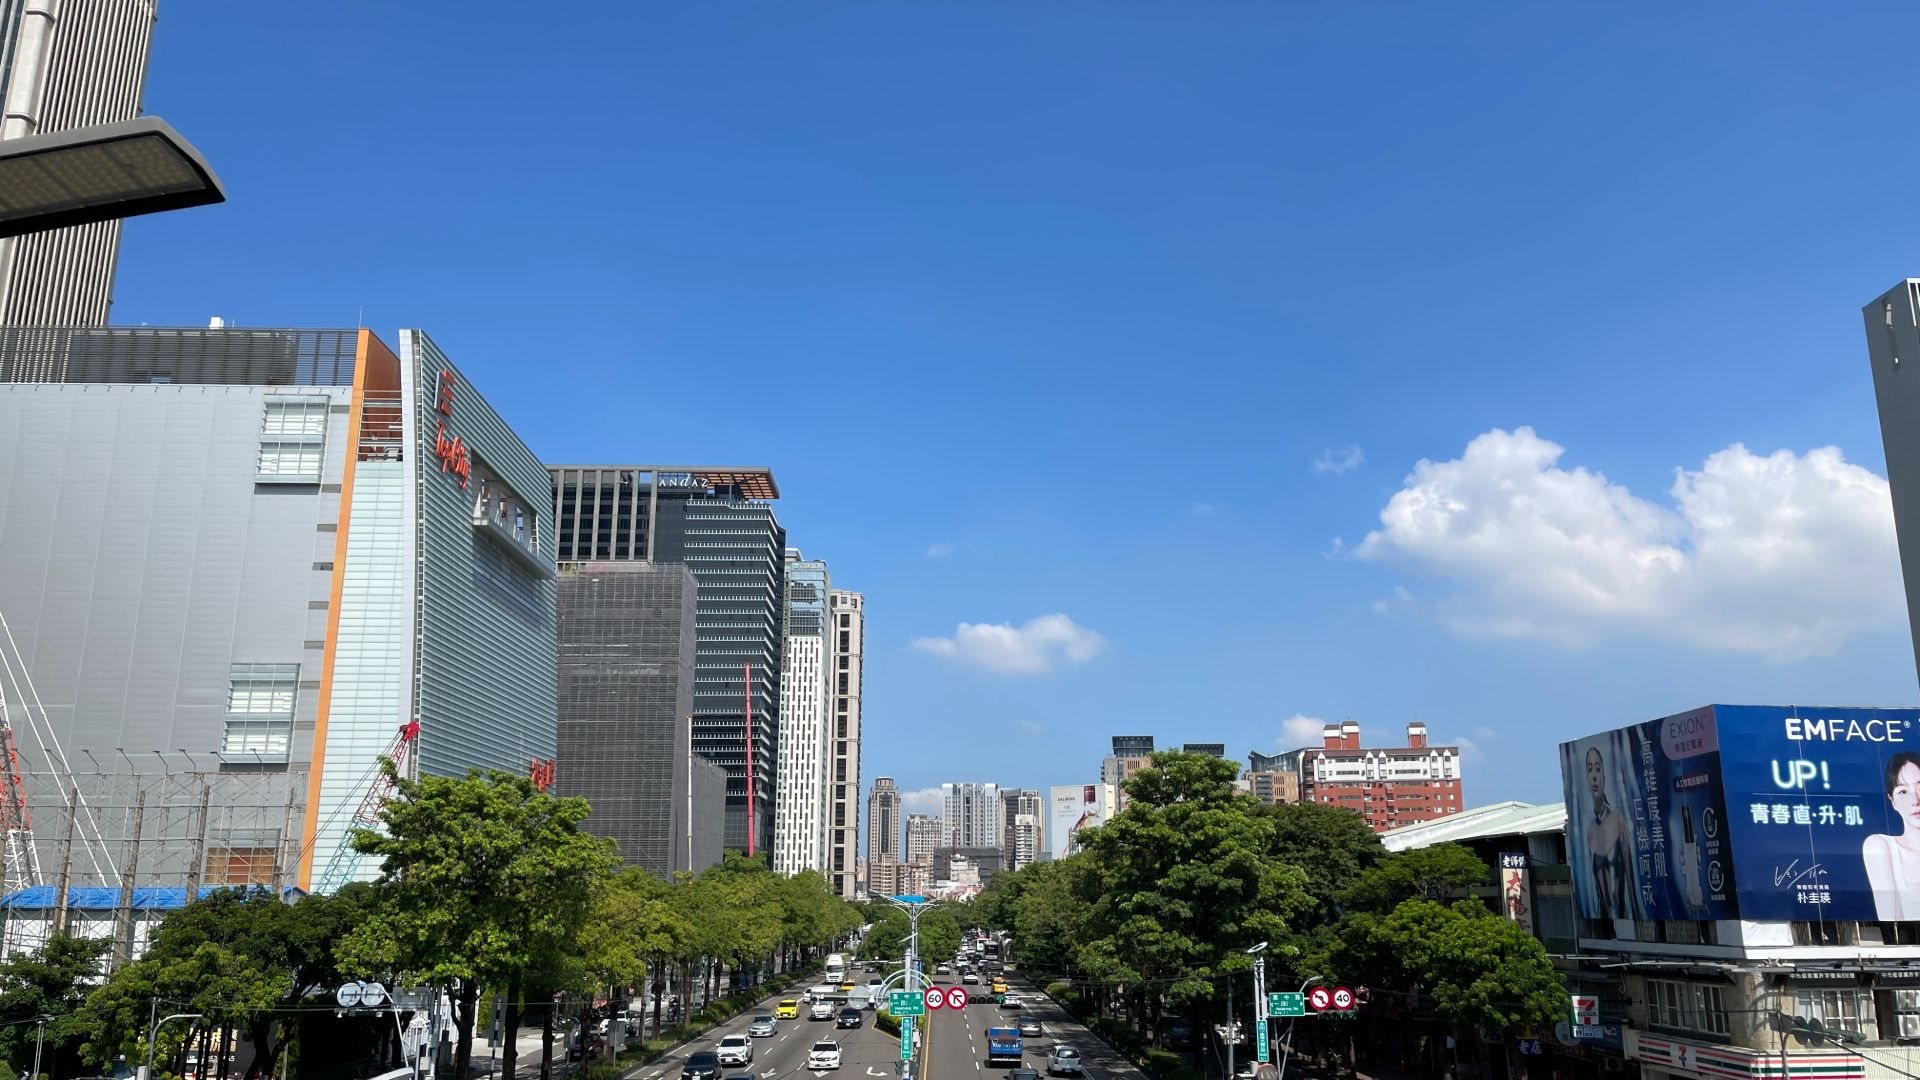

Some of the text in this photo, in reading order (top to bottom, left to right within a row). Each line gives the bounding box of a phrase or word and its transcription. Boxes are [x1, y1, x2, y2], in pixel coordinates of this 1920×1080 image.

[1771, 759, 1831, 789] UP!
[1797, 892, 1831, 904] 朴圭瑛
[928, 994, 942, 1003] 60
[1336, 994, 1350, 1003] 40
